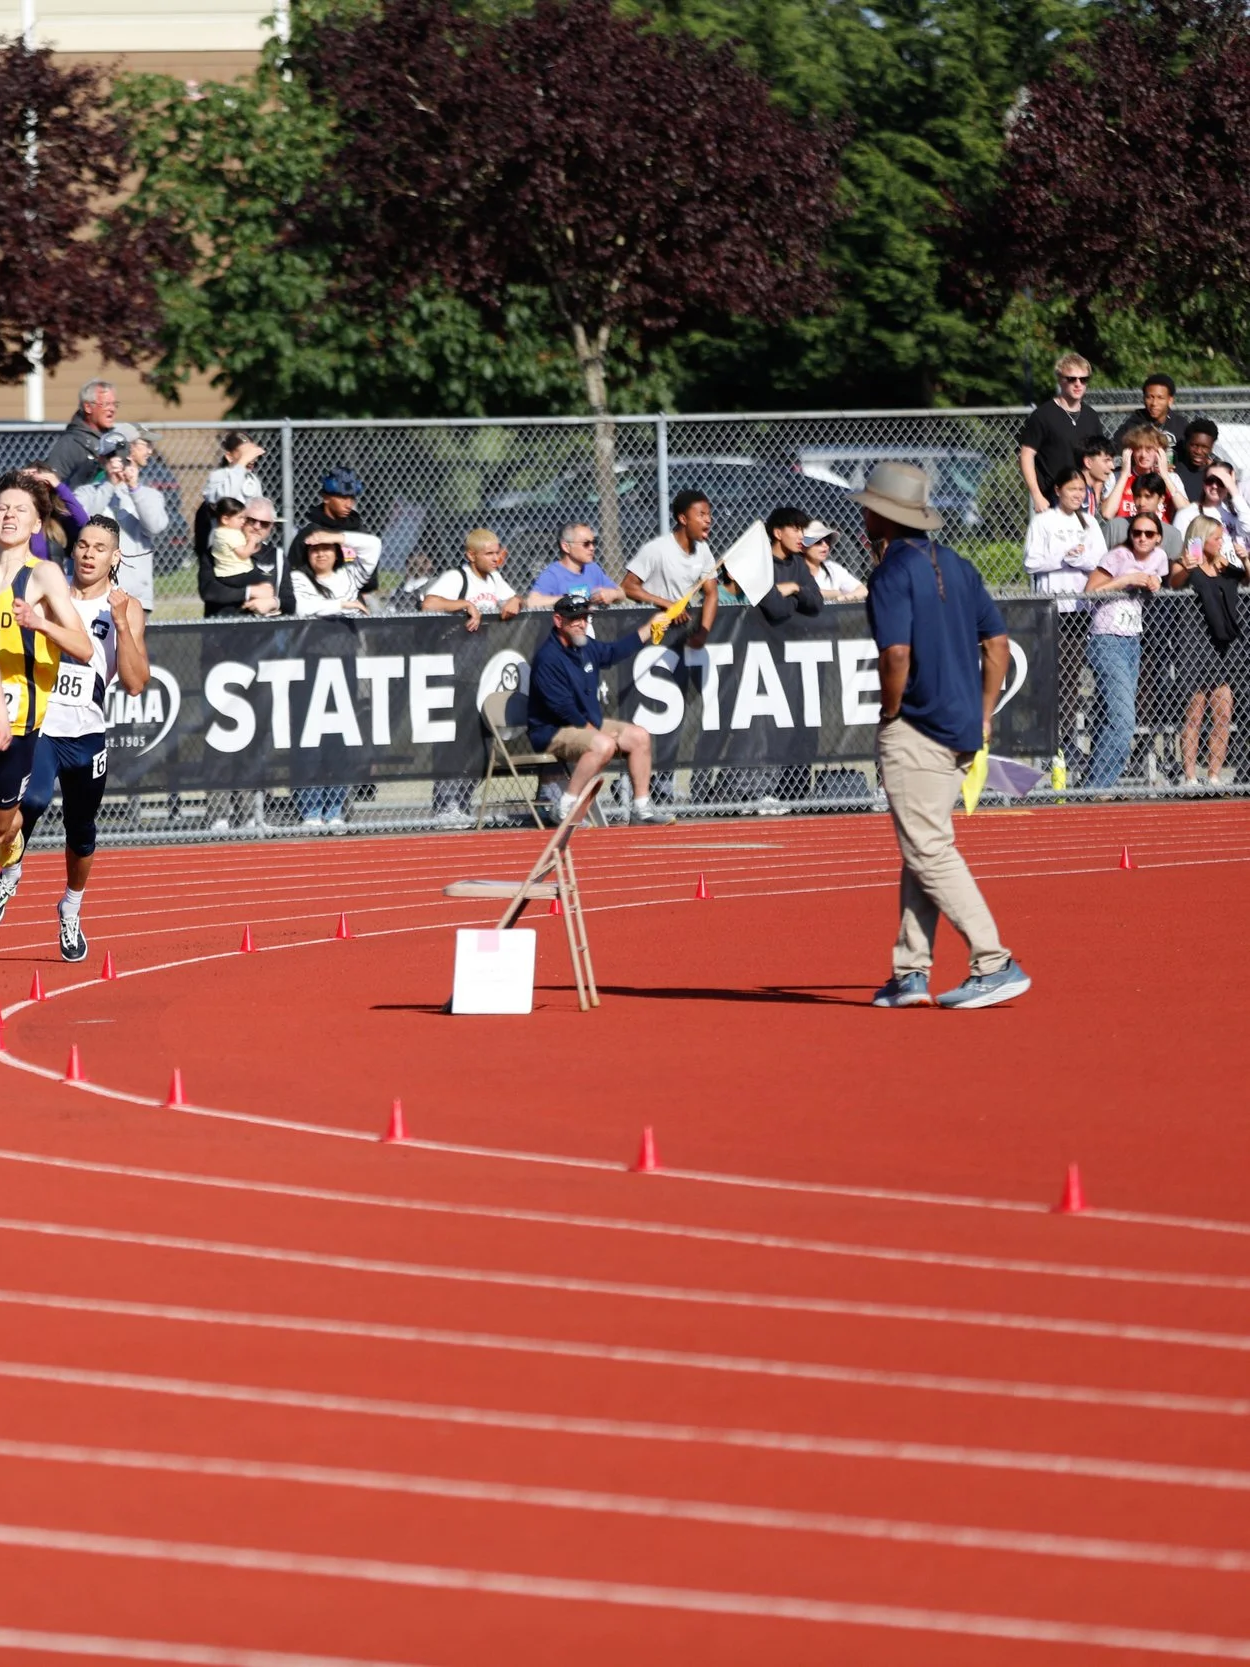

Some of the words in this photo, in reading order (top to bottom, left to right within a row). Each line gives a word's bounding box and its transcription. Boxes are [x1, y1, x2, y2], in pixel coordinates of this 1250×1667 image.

[204, 653, 456, 753] STATE
[632, 638, 881, 734] STATE
[105, 736, 146, 748] st.1905
